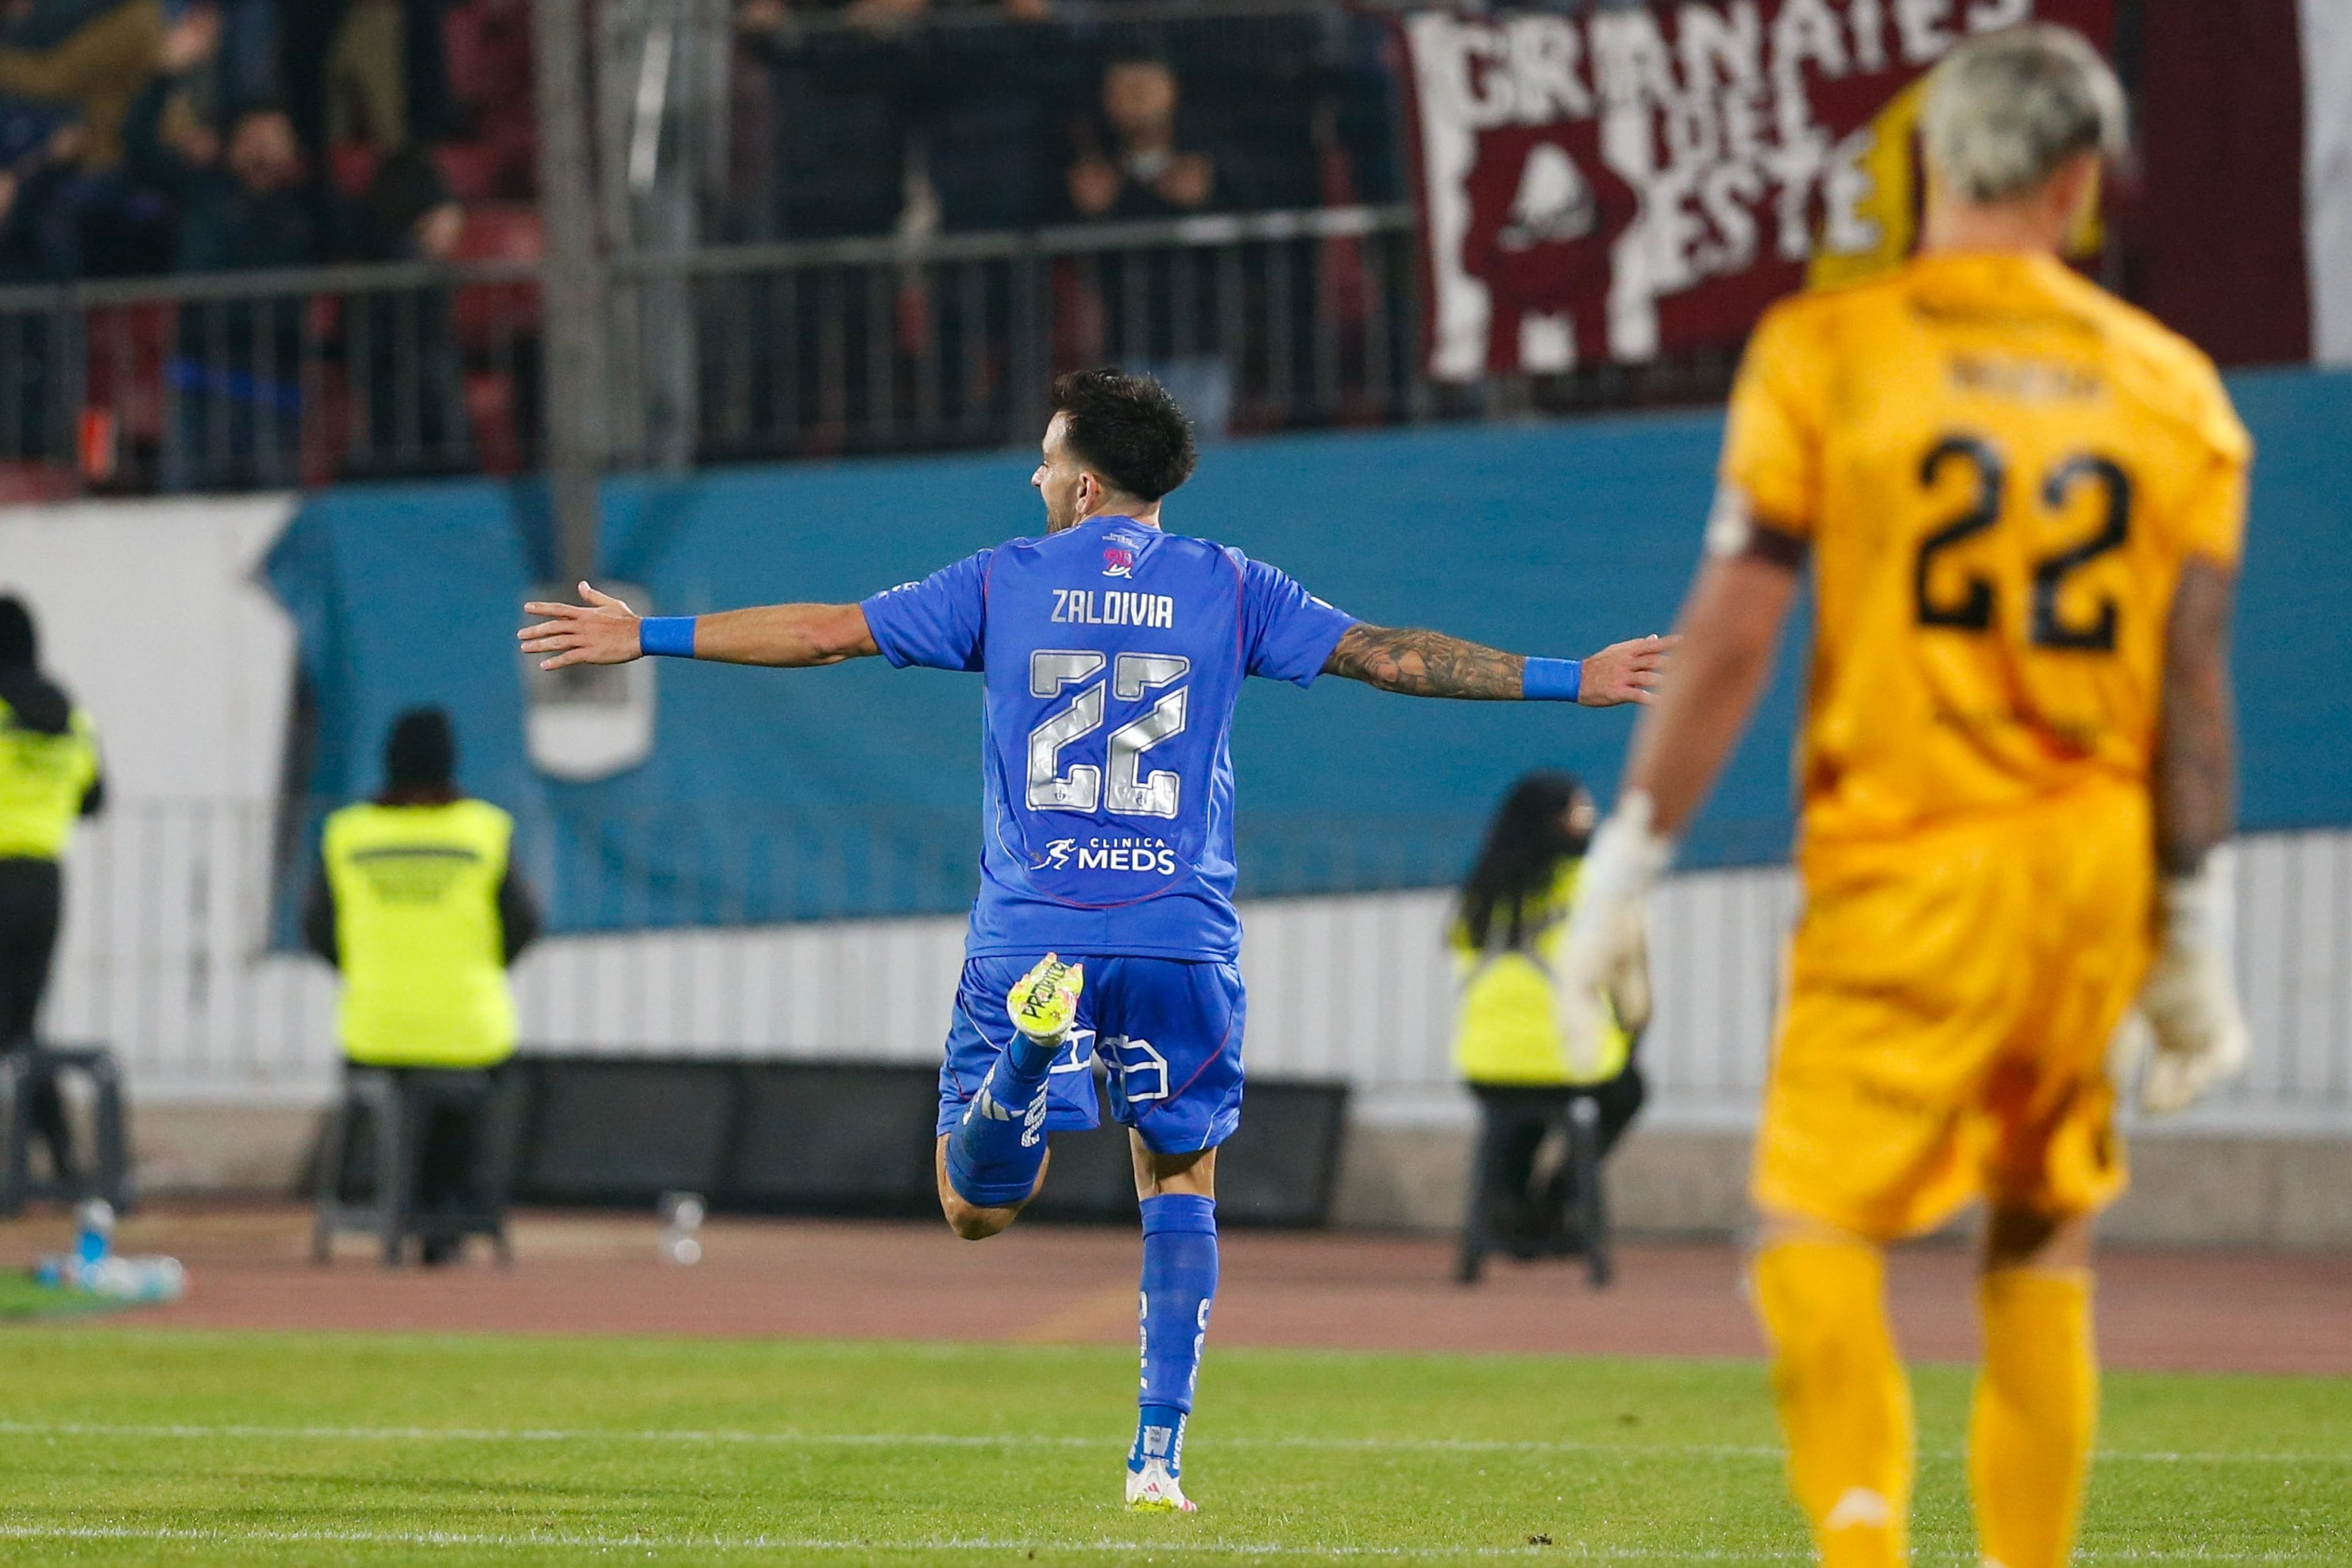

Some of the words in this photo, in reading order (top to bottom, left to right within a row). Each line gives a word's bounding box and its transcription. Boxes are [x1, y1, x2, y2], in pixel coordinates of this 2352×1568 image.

[1666, 75, 1833, 168] DEL
[1644, 131, 1883, 292] ESTE
[1919, 435, 2134, 653] 22
[1051, 589, 1173, 628] ZALDIVIA
[1025, 649, 1190, 820] 22
[1078, 848, 1176, 875] MEDS
[1090, 838, 1165, 848] CLINICA
